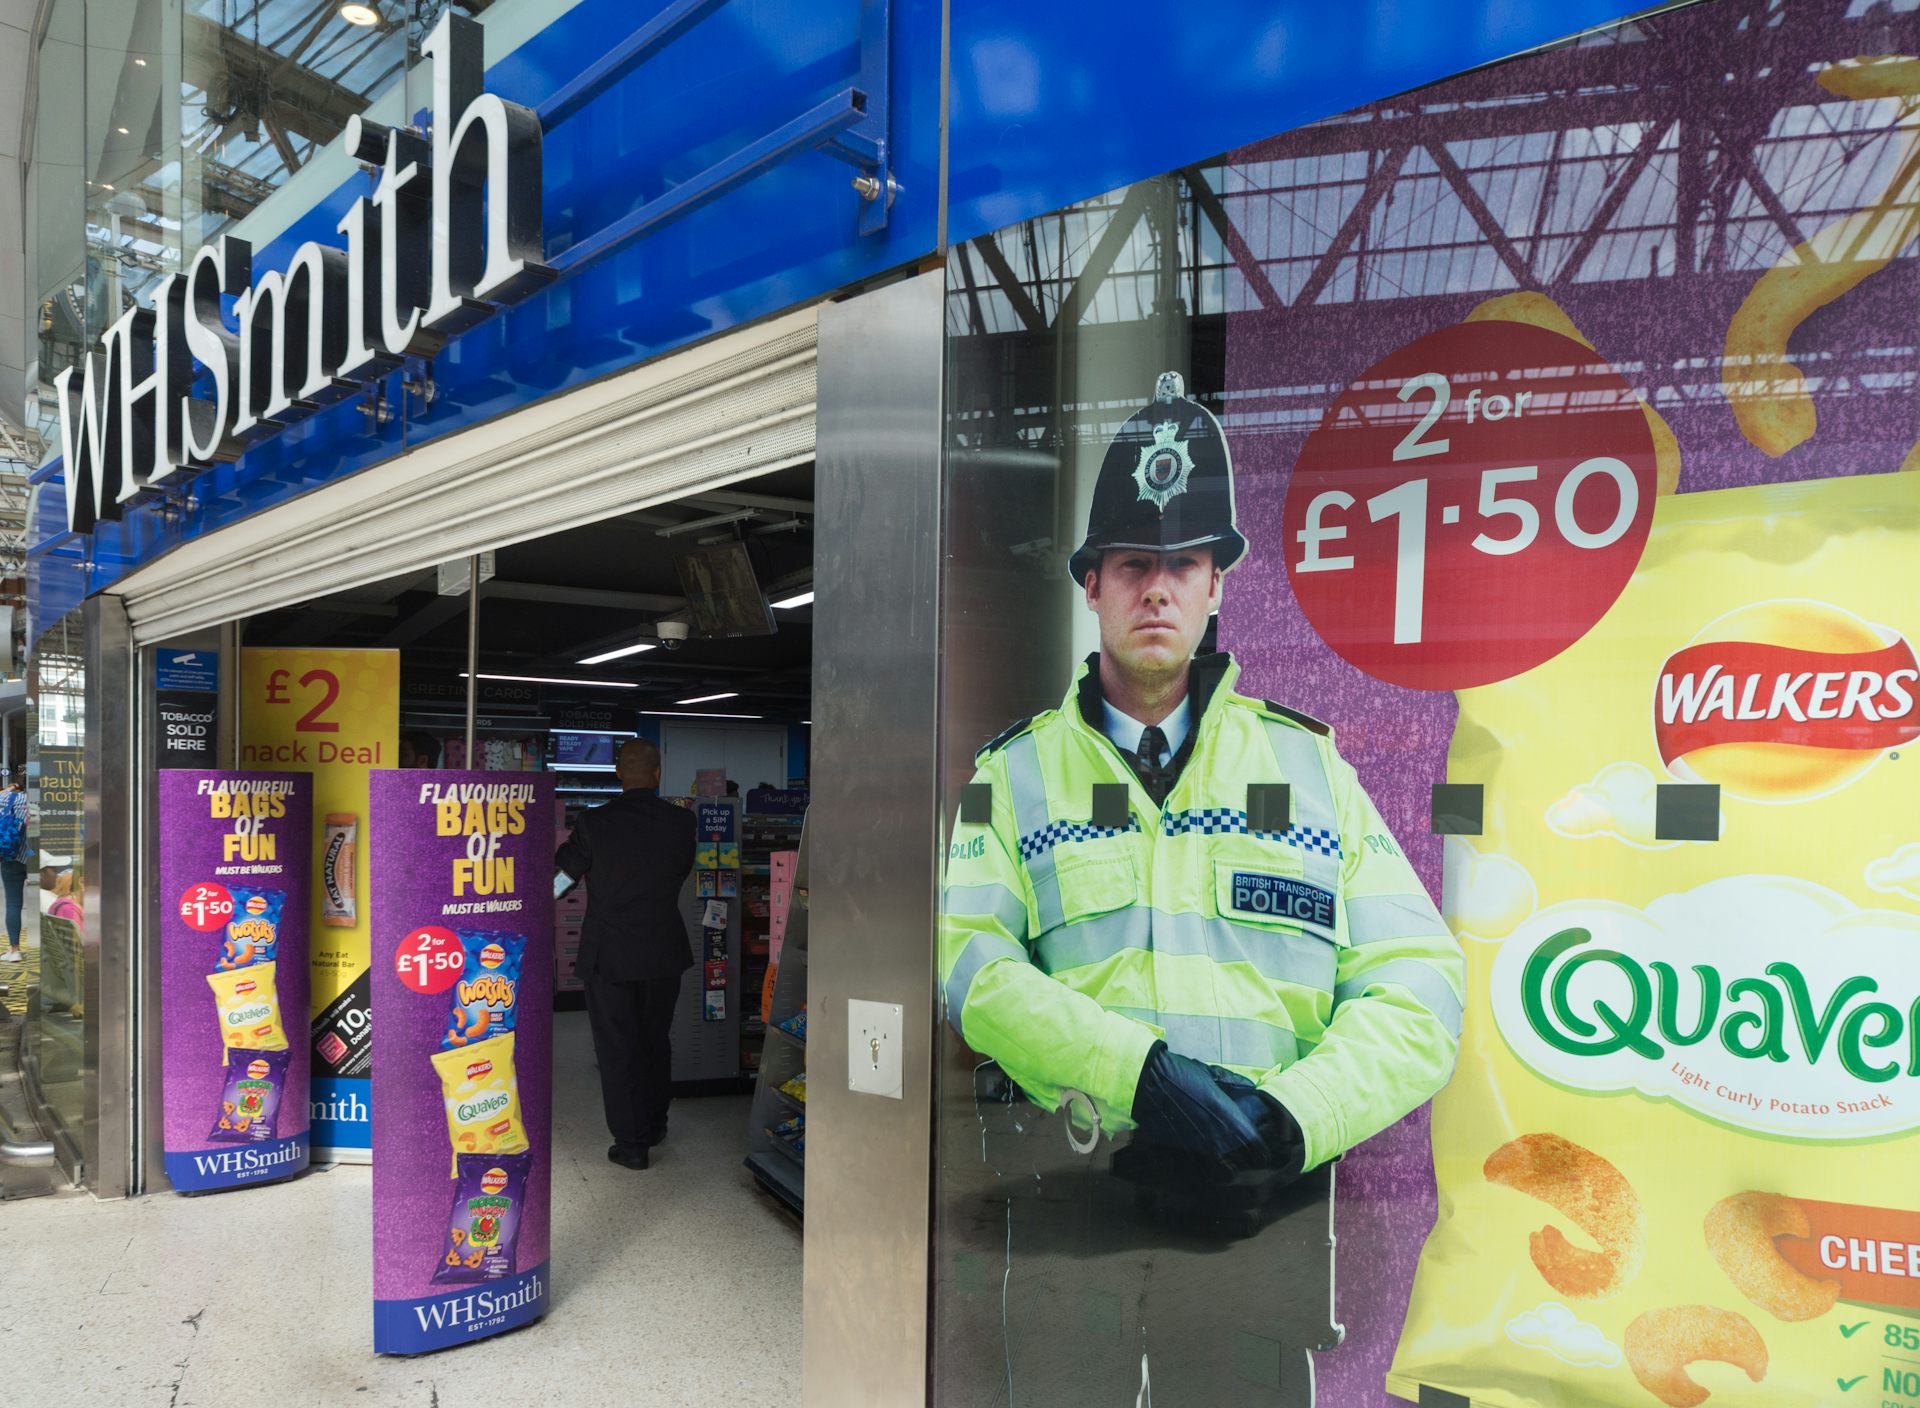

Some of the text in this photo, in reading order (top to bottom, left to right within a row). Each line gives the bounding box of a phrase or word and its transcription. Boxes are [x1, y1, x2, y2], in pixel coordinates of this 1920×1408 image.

[54, 8, 525, 532] WHSmith
[1392, 372, 1532, 461] 2 for
[265, 669, 340, 733] £2
[407, 683, 533, 699] GREETIN CARDS
[1661, 664, 1919, 725] WALKERS
[160, 711, 213, 723] TOBACCO
[560, 710, 612, 720] TOBACCO
[587, 721, 611, 729] HERE
[166, 724, 207, 737] SOLD
[167, 738, 206, 750] HERE
[319, 741, 381, 764] Deal
[197, 779, 295, 796] FLAVOURFUL
[419, 783, 537, 804] FLAVOURFUL
[210, 791, 286, 818] BAGS
[702, 808, 718, 816] Pick
[235, 814, 268, 838] OF
[436, 799, 526, 836] BAGS
[705, 824, 727, 832] today
[712, 816, 727, 824] SIM
[223, 834, 276, 862] FUN
[466, 831, 504, 862] OF
[950, 834, 985, 860] OLICE
[215, 865, 239, 875] MUST
[325, 836, 344, 885] NATURAL
[453, 857, 515, 896] FUN
[195, 887, 208, 900] 2
[1235, 875, 1332, 905] BRITISH TRANSPORT
[442, 899, 523, 915] MUST BE WALKERS
[1235, 887, 1331, 924] POLICE
[417, 933, 446, 951] 2 for
[312, 960, 339, 968] Natural
[319, 951, 334, 959] Any
[1671, 1061, 1894, 1115] Light Curly Potato Snack
[193, 1141, 301, 1176] WHSmith
[413, 1274, 544, 1333] WHSmith
[1884, 1323, 1919, 1351] 85
[1882, 1367, 1920, 1398] NO
